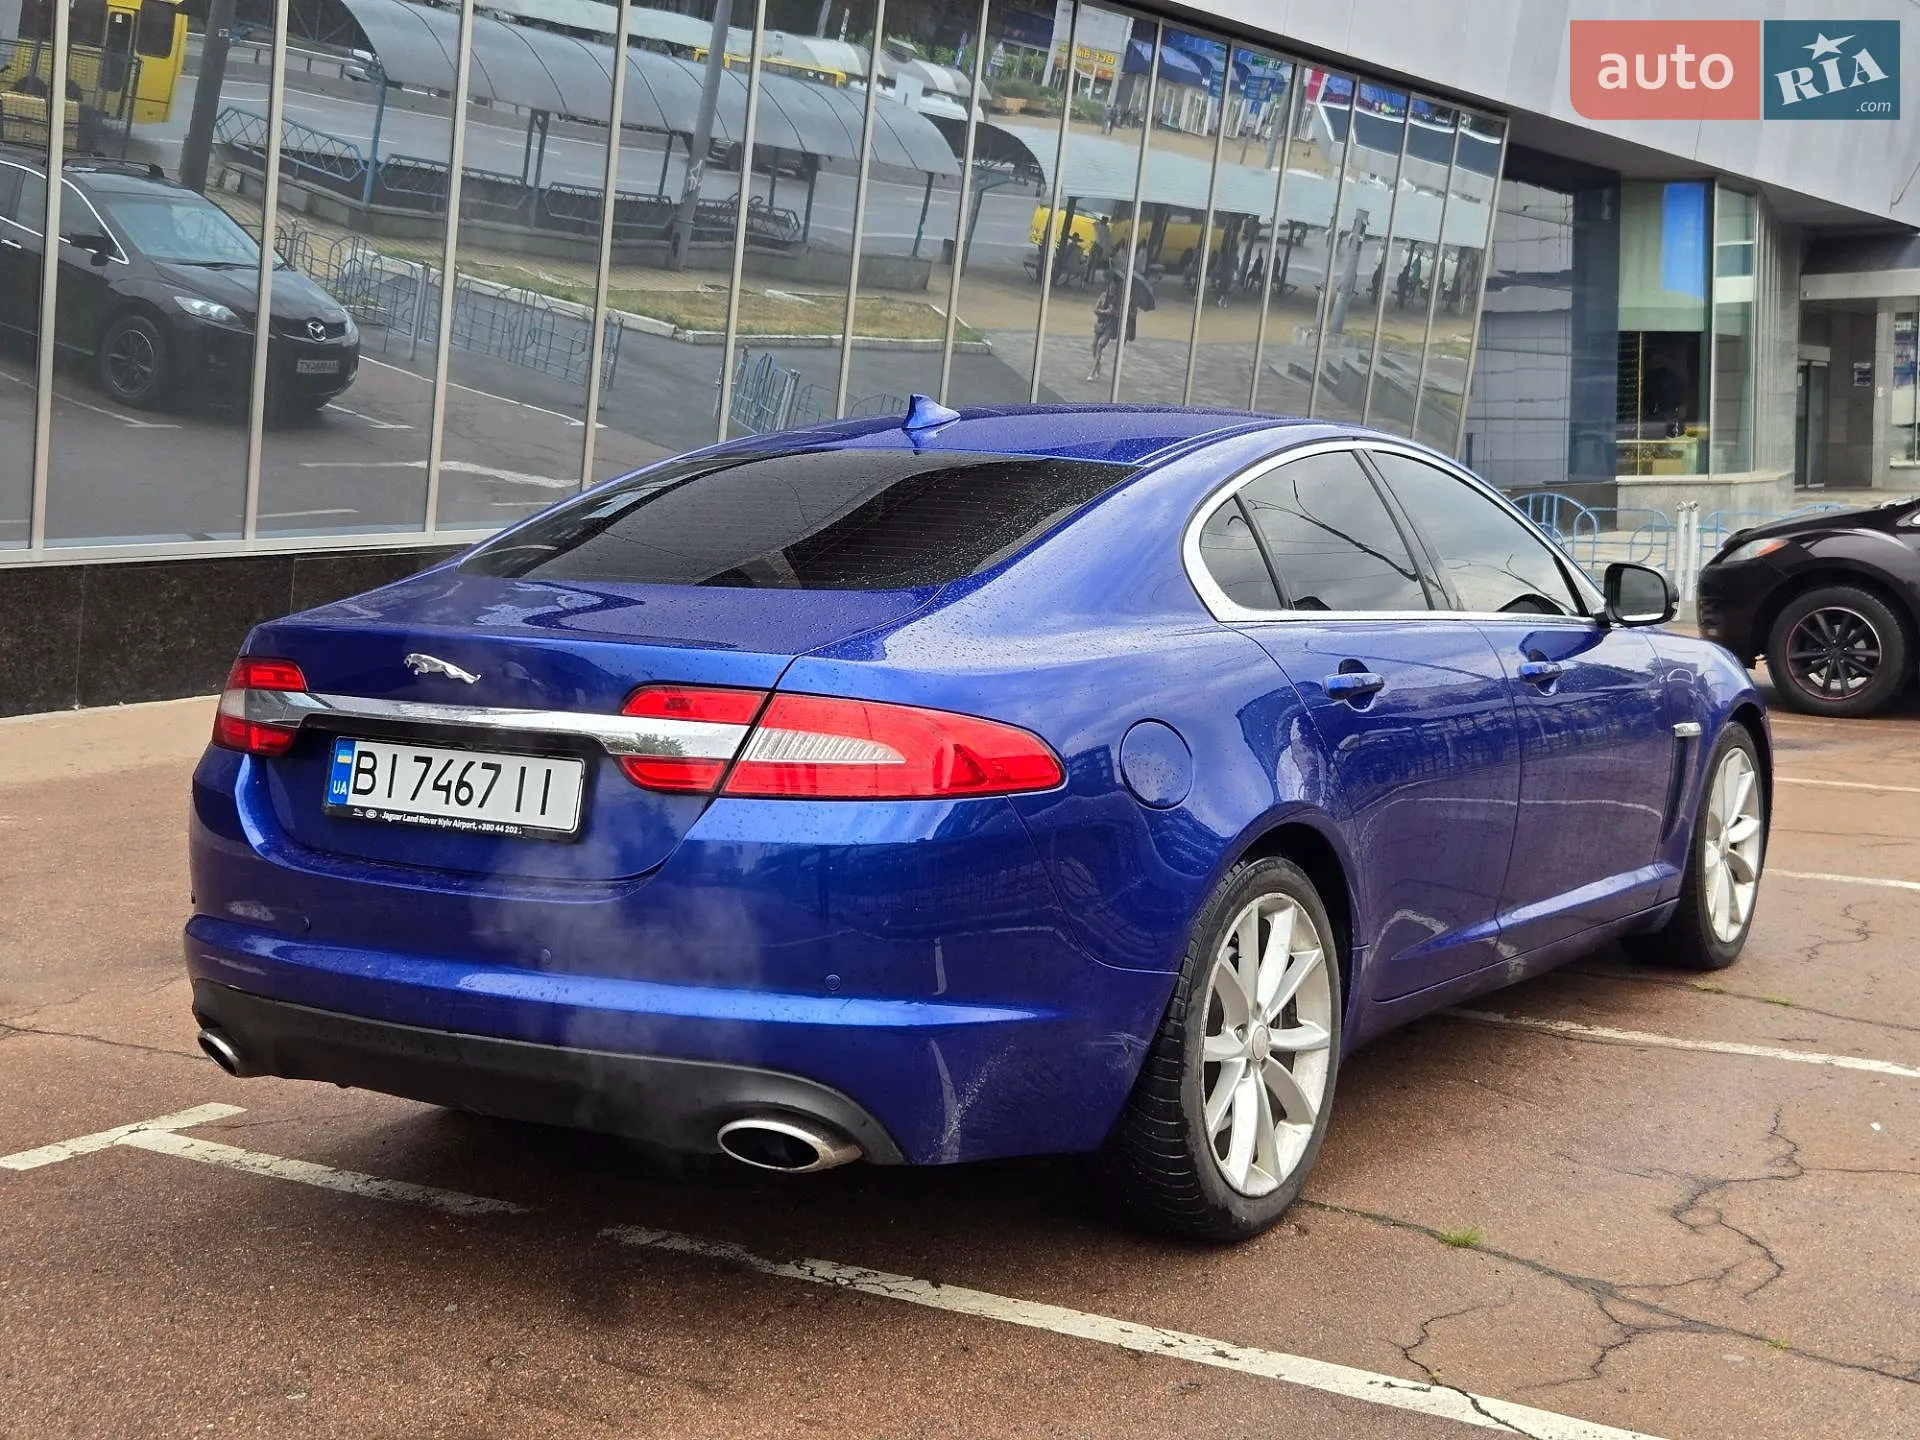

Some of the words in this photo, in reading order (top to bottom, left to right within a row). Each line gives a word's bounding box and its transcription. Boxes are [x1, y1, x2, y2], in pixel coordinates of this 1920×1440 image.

[332, 779, 348, 795] UA
[381, 811, 404, 822] Jaguar
[402, 813, 419, 823] Land
[419, 815, 437, 825] Rover
